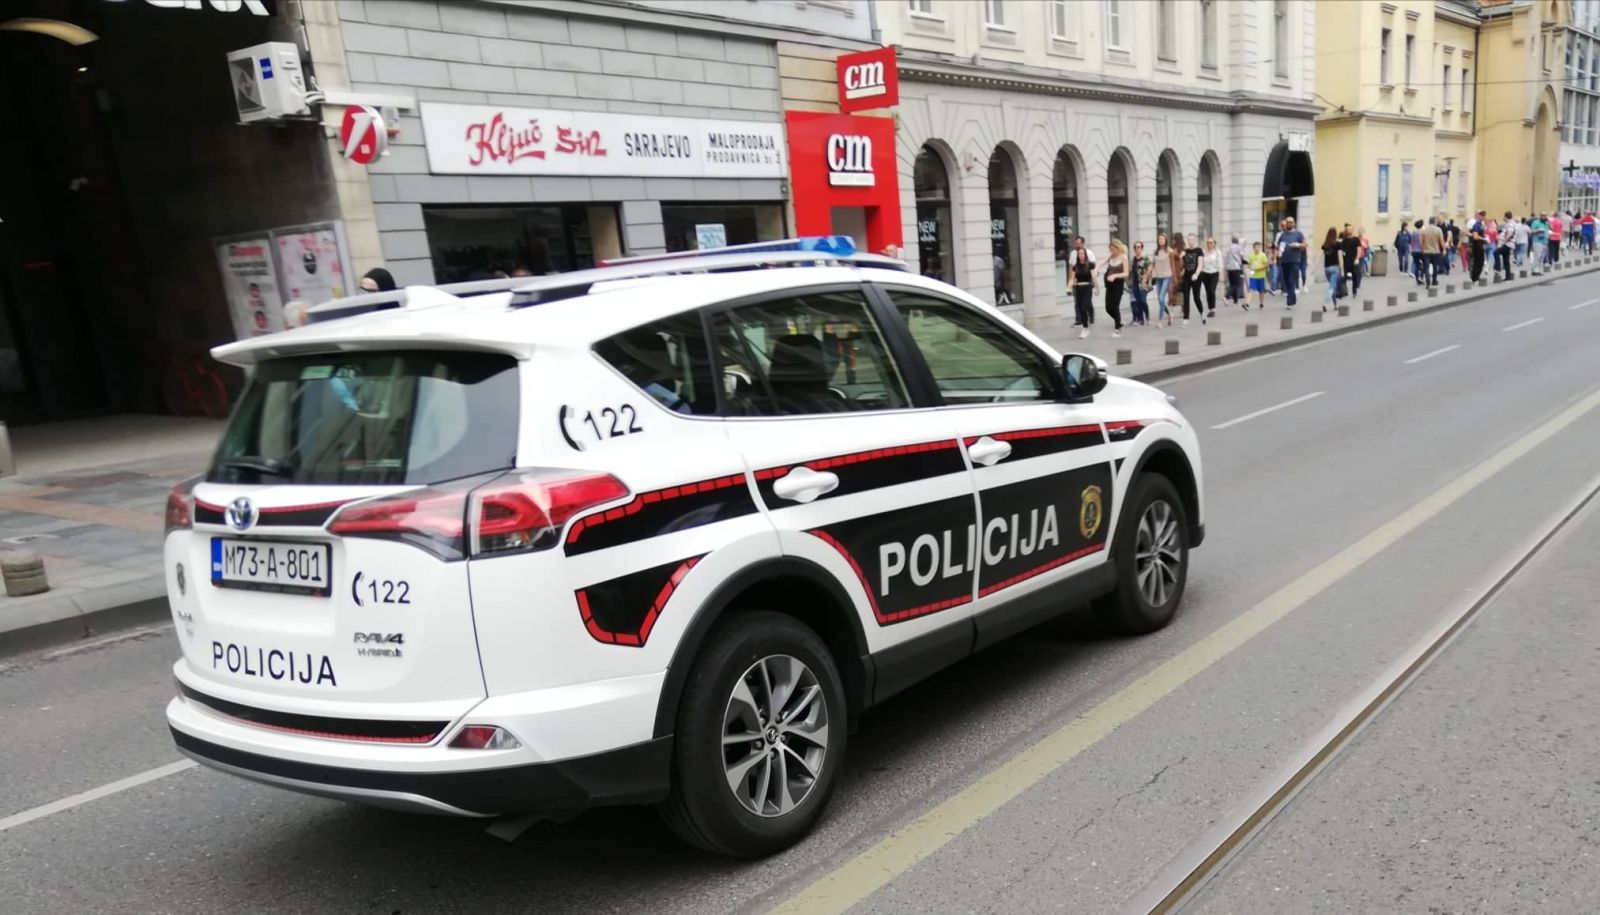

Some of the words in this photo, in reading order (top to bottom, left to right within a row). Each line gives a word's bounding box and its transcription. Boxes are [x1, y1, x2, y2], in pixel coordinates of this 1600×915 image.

[845, 61, 885, 90] cm
[624, 132, 691, 158] SARAJEVO
[706, 151, 761, 164] PRODAVNICA
[708, 132, 775, 150] MALOPRODAJA
[827, 133, 874, 172] cm
[584, 403, 644, 441] 122
[224, 544, 322, 582] M73-A-801
[879, 504, 1059, 597] POLICIJA
[368, 579, 411, 604] 122
[212, 640, 338, 687] POLICIJA
